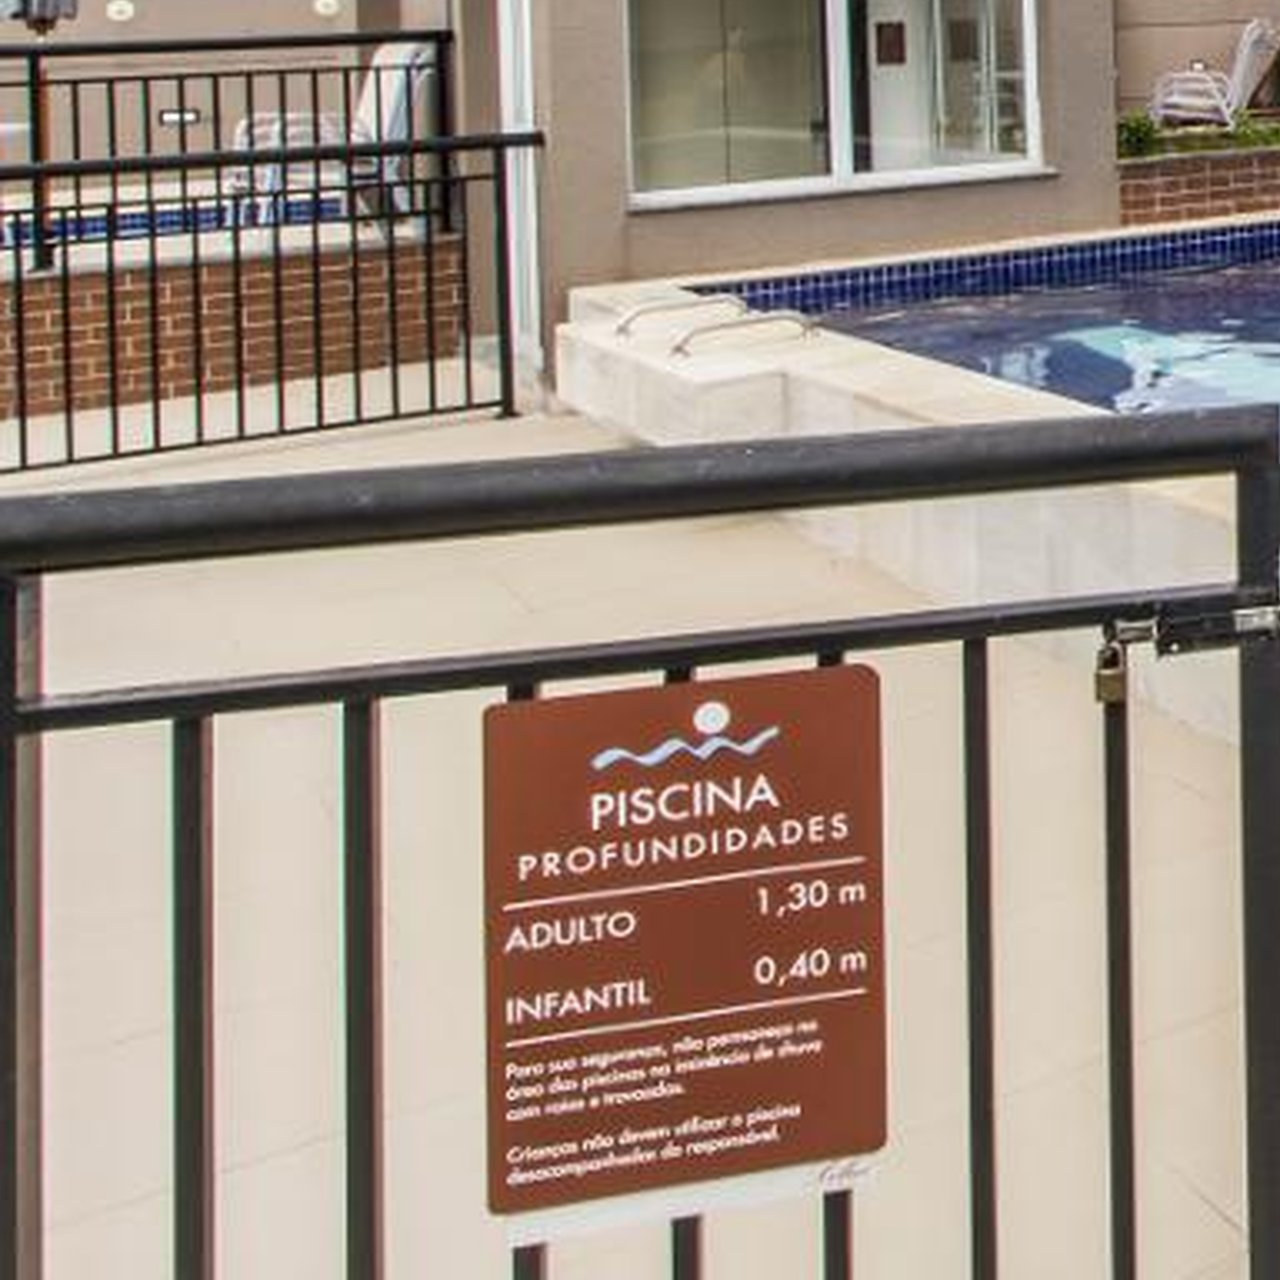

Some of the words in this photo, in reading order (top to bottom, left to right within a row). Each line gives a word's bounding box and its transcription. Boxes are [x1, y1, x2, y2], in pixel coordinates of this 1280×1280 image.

[590, 773, 779, 830] PISCINA
[517, 813, 849, 881] PROFUNDIDADES
[503, 911, 636, 953] ADULTO
[756, 880, 829, 917] 1,30
[838, 881, 866, 904] m
[505, 978, 651, 1024] INFANTIL
[754, 948, 830, 987] 0,40
[840, 950, 867, 973] m
[506, 1063, 544, 1079] Para
[549, 1058, 577, 1073] sua
[549, 1076, 578, 1093] das
[582, 1070, 646, 1092] piscinas
[506, 1105, 541, 1121] com
[506, 1142, 578, 1163] Crianças
[582, 1134, 614, 1151] não
